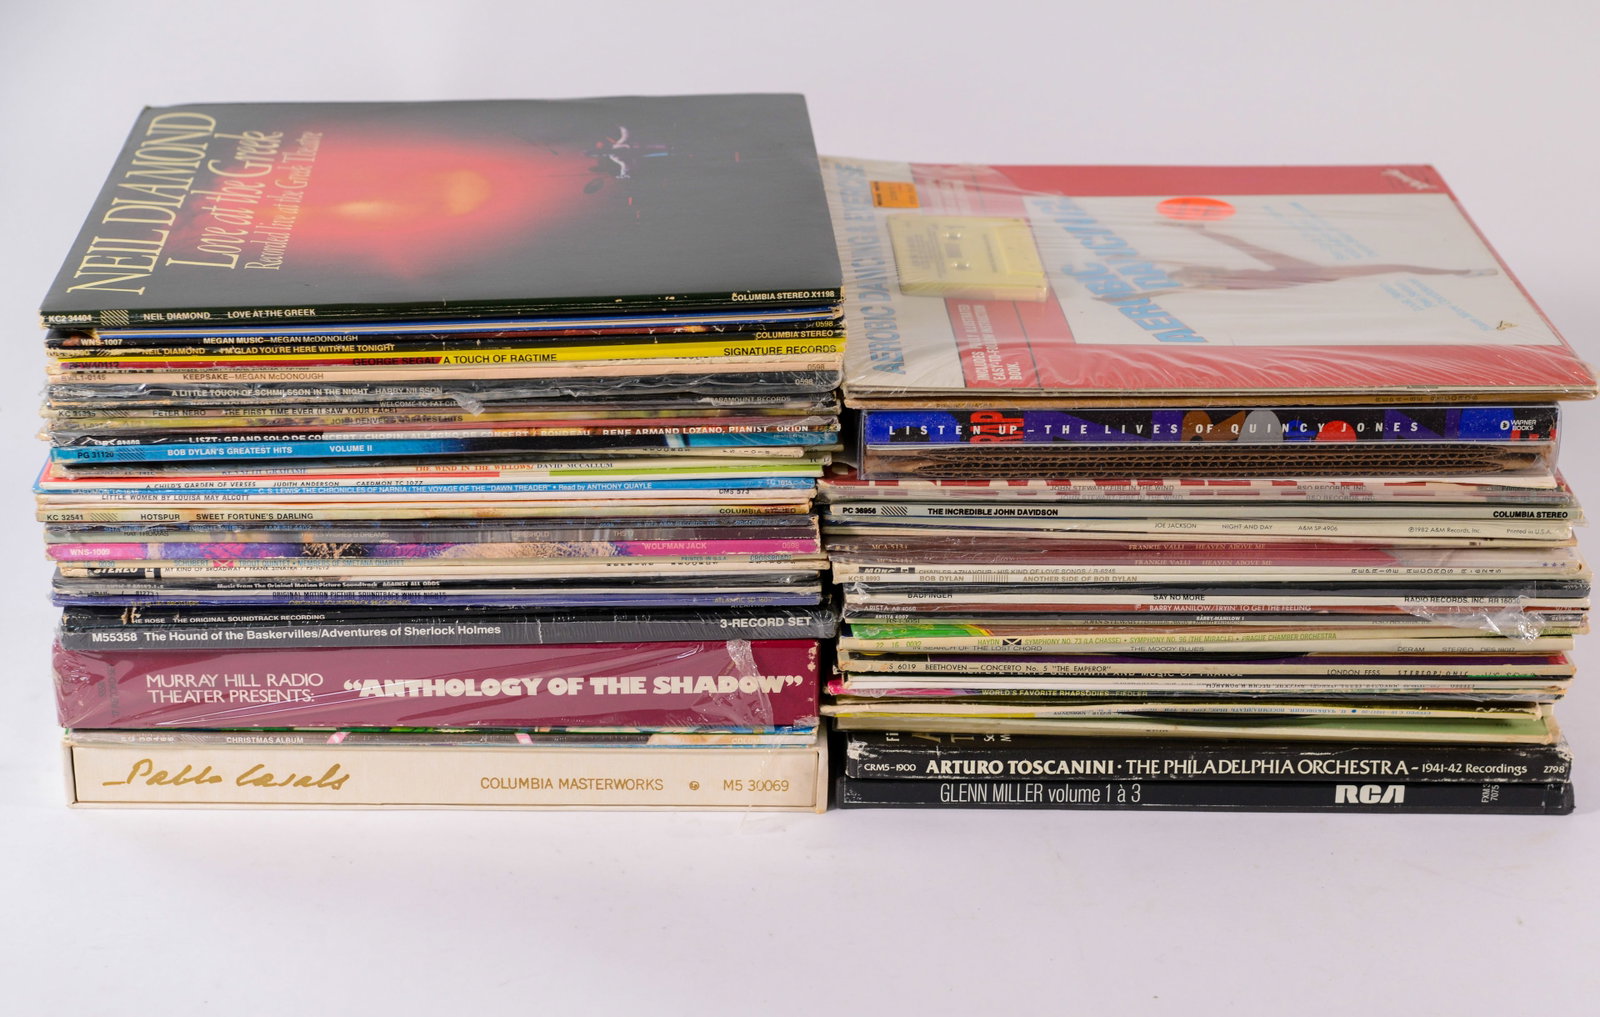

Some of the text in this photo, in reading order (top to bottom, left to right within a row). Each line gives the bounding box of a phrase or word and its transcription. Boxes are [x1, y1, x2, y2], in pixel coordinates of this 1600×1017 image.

[102, 111, 217, 225] DIAMOND
[166, 130, 284, 270] Love at the Greek
[66, 220, 171, 295] NEIL
[732, 293, 776, 302] COLUMBIA
[49, 314, 92, 322] KC2 34404
[167, 312, 211, 320] DIAMOND
[284, 308, 316, 316] GREEK
[302, 335, 358, 343] McDONOUGH
[756, 331, 800, 339] COLUMBIA
[864, 305, 906, 375] AEROBIC
[259, 346, 292, 354] YOU'RE
[357, 344, 395, 352] TONIGHT
[724, 344, 837, 356] SIGNATURE RECORDS
[352, 357, 400, 366] GEORGE
[454, 356, 490, 364] TOUCH
[492, 355, 507, 363] OF
[510, 353, 557, 362] RAGTIME
[268, 372, 324, 380] McDONOUGH
[889, 422, 1418, 435] LISTEN UP THE LIVES OF QUINCY JONES
[188, 448, 224, 456] DYLAN'S
[641, 542, 685, 550] WOLFMAN
[720, 616, 812, 629] 3-RECORD SET
[92, 625, 501, 642] M55358 The Hound of the Baskervilles/Adventures of Sherlock Holmes
[146, 673, 324, 688] MURRAY HILL RADIO
[548, 678, 584, 696] OF
[590, 676, 647, 695] THE
[150, 689, 315, 704] THEATER PRESENTS:
[925, 759, 1565, 776] ARTURO TOSCANINI THE PHILADELPHIA ORCHESTRA 1941-42 Recordings 2798
[235, 763, 350, 790] Casals
[480, 777, 789, 792] COLUMBIA MASTERWORKS M5 30069
[940, 783, 1141, 802] GLENN MILLER volume 1 à 3
[1335, 785, 1406, 804] RCA
[1490, 785, 1499, 801] 7075
